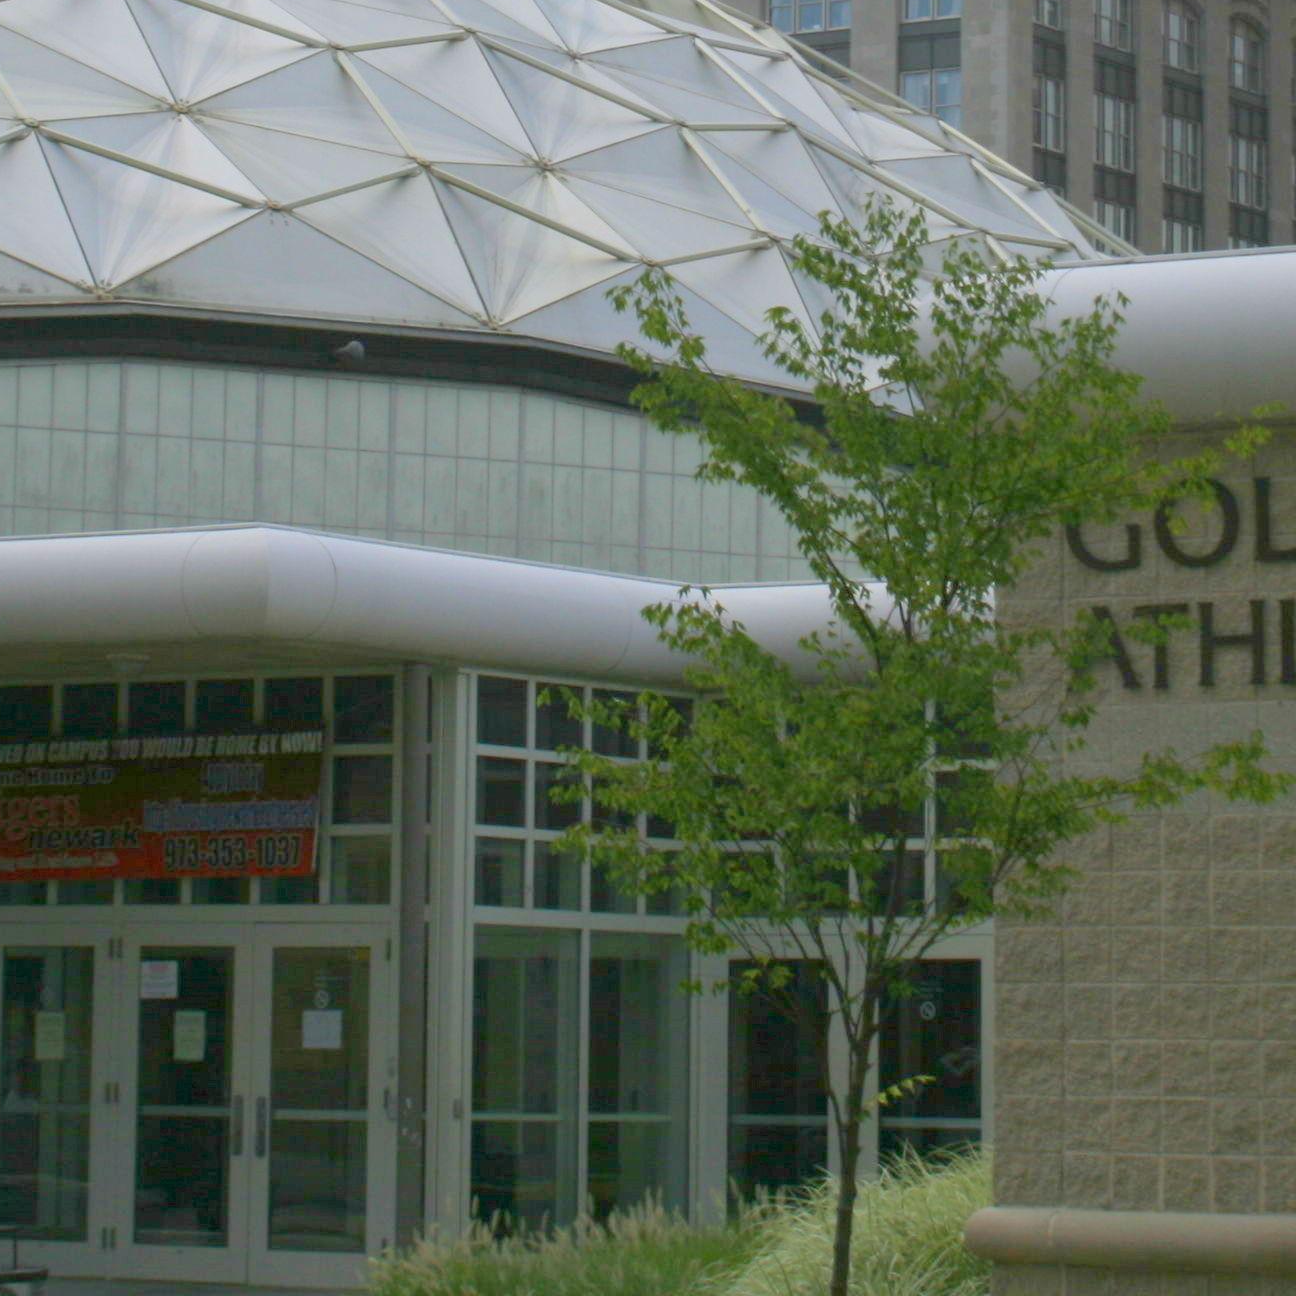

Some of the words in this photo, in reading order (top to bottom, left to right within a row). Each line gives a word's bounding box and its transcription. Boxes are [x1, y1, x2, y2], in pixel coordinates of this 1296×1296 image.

[48, 740, 109, 762] CAMPUS
[142, 737, 191, 759] WOULD
[29, 822, 140, 849] newark
[164, 835, 301, 871] 973-353-1037
